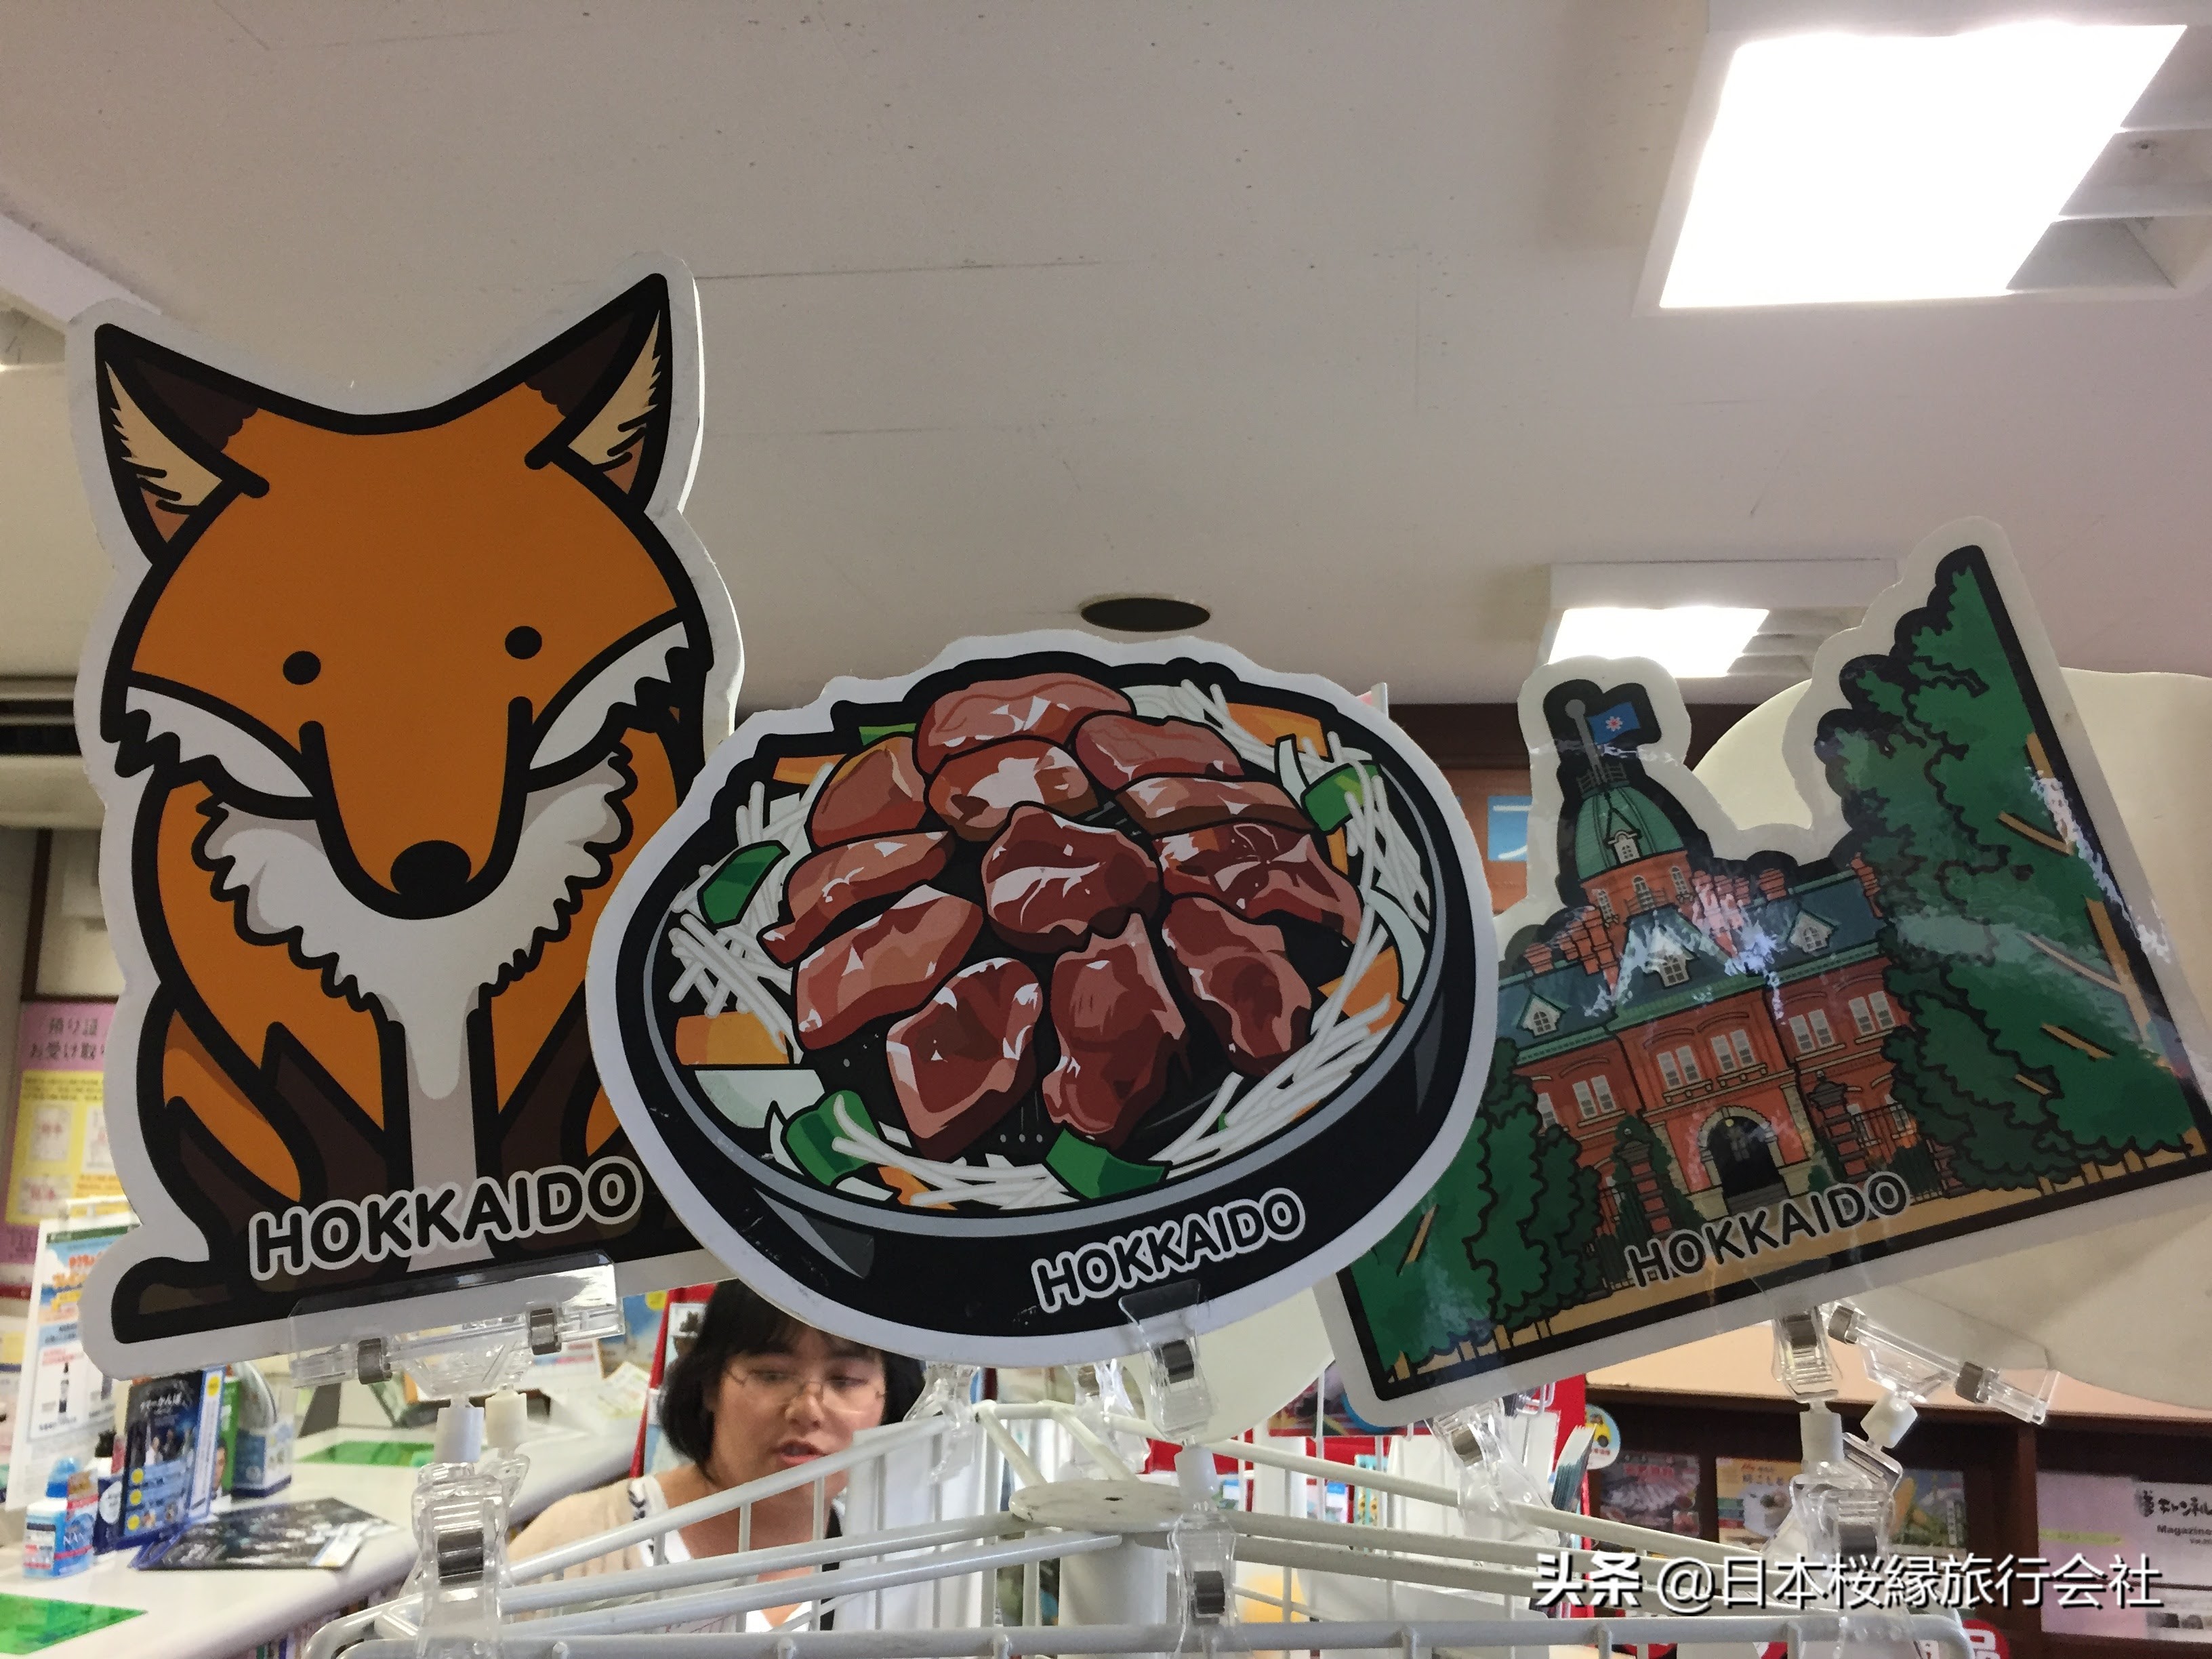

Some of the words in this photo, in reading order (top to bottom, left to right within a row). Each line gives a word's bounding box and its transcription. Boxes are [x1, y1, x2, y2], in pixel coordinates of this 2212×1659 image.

[249, 1155, 644, 1281] HOKKAIDO
[1031, 1187, 1306, 1313] HOKKAIDO
[1624, 1171, 1910, 1290] HOKKAIDO
